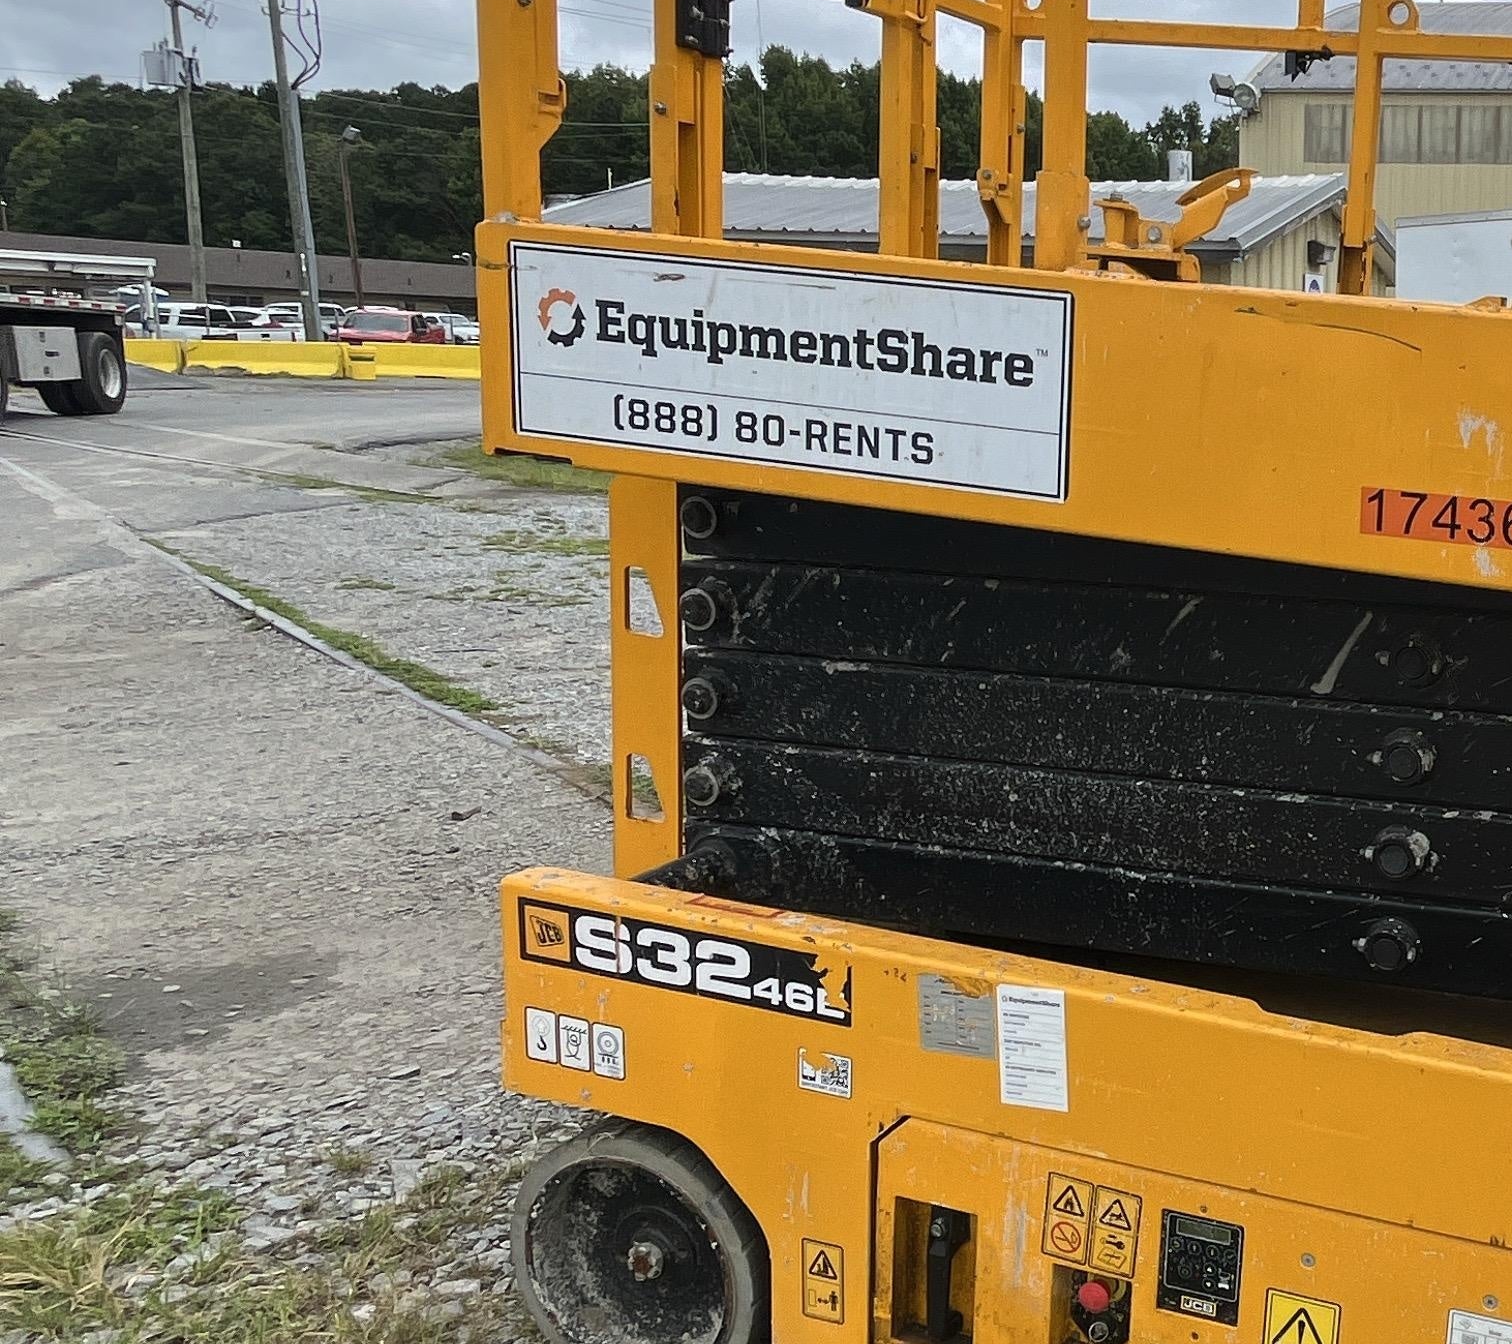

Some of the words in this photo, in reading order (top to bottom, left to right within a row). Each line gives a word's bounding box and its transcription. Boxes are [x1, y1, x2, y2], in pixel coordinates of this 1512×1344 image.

[595, 298, 1034, 388] EquipmentShare
[613, 393, 718, 442] (888)
[735, 411, 935, 465] 80-RENTS
[534, 917, 565, 946] JCB
